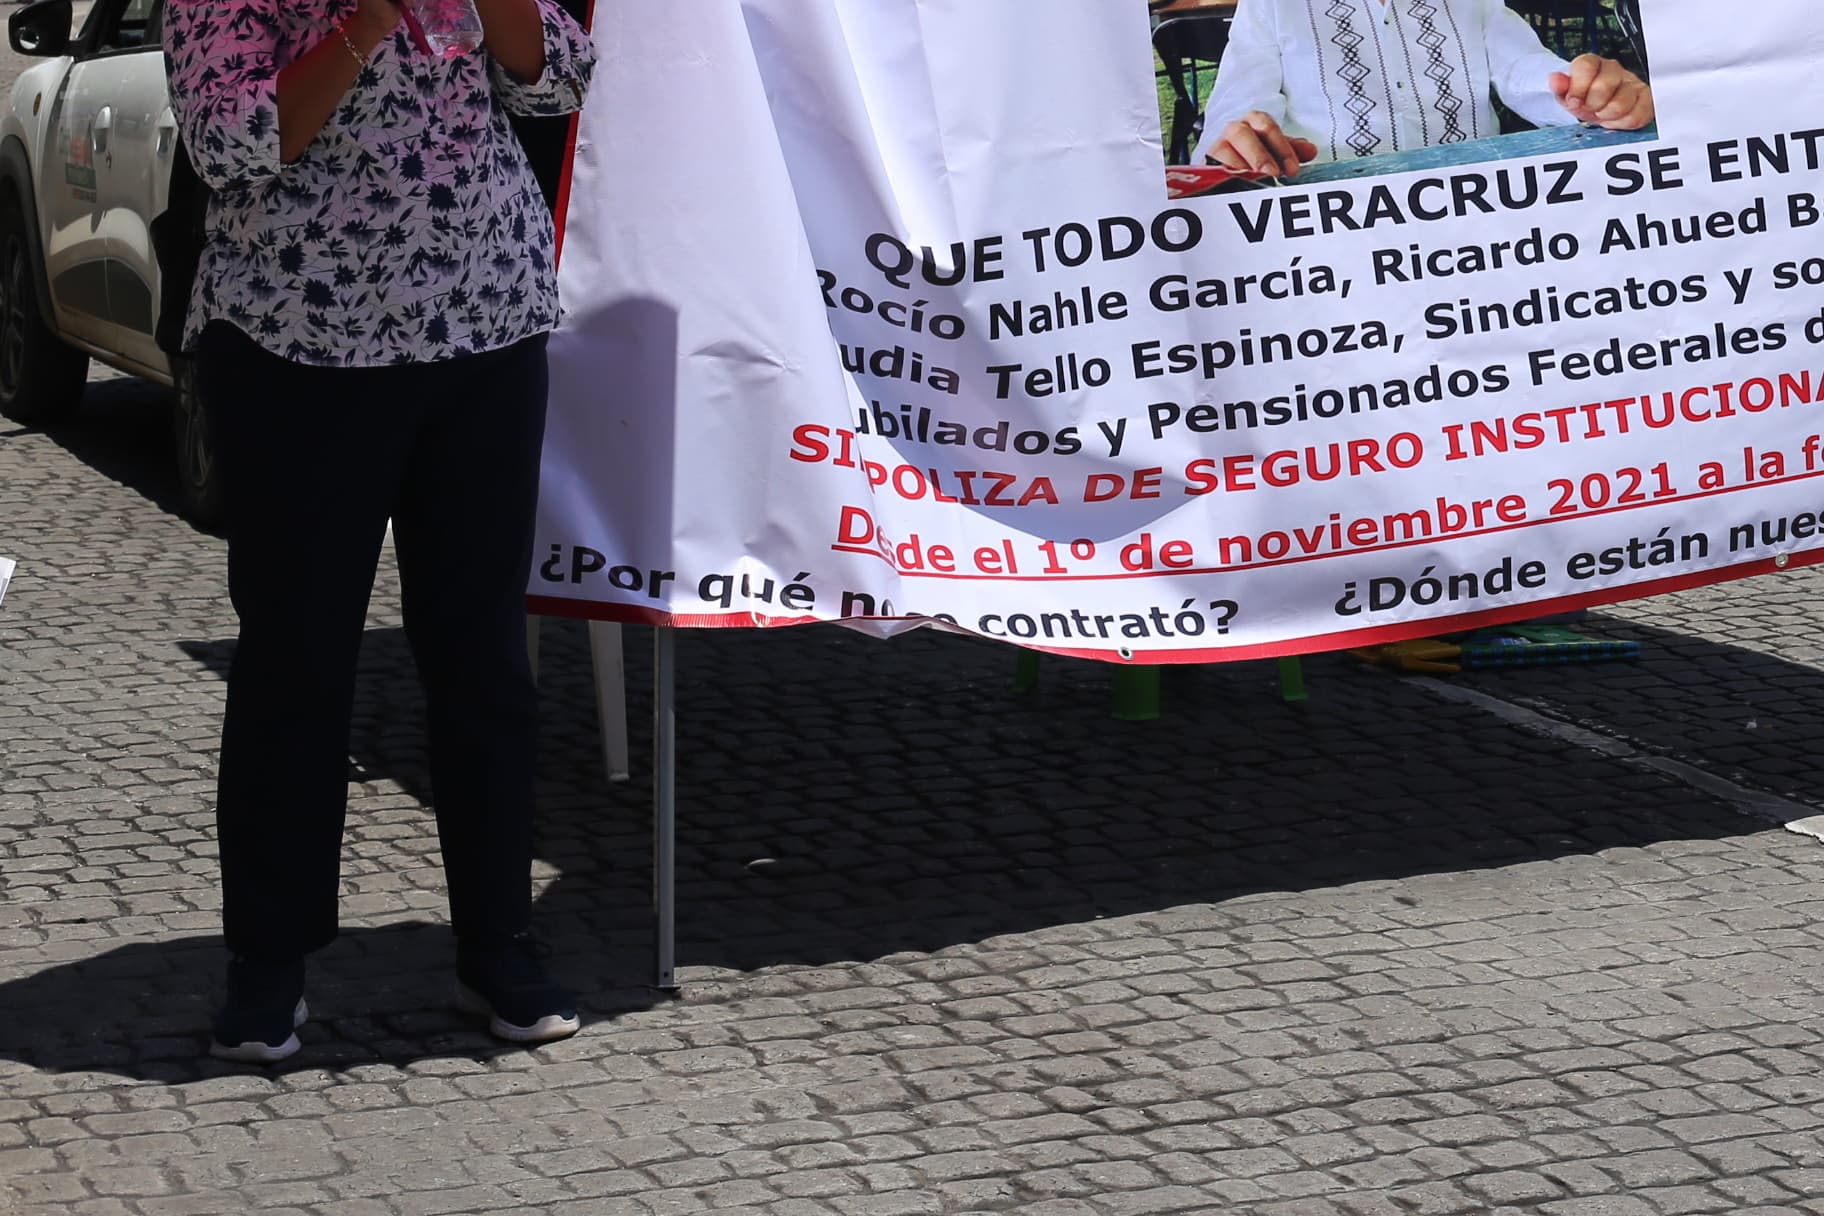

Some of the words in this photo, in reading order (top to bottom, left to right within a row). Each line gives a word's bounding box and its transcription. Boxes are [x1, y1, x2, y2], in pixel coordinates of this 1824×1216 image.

[816, 268, 966, 340] Rocío
[989, 285, 1129, 341] Nahle
[1149, 257, 1354, 314] García,
[1371, 227, 1580, 287] Ricardo
[1599, 196, 1768, 257] Ahued
[865, 233, 1006, 290] QUE
[1022, 208, 1204, 273] TODO
[1228, 160, 1584, 244] VERACRUZ
[1604, 146, 1684, 200] SE
[986, 352, 1111, 400] Tello
[1132, 320, 1406, 381] Espinoza,
[1424, 273, 1709, 340] Sindicatos
[1722, 265, 1754, 306] y
[1098, 417, 1128, 458] y
[1148, 364, 1511, 439] Pensionados
[1527, 319, 1788, 388] Federales
[861, 461, 1059, 508] POLIZA
[1083, 467, 1164, 503] DE
[1184, 431, 1424, 497] SEGURO
[974, 540, 1018, 575] el
[1119, 532, 1194, 572] de
[1219, 493, 1528, 565] noviembre
[1548, 461, 1679, 517] 2021
[1698, 461, 1726, 491] a
[1743, 445, 1786, 483] la
[540, 543, 676, 600] ¿Por
[698, 572, 818, 610] qué
[978, 598, 1240, 640] contrató?
[1334, 554, 1546, 618] ¿Dónde
[1566, 525, 1709, 582] están
